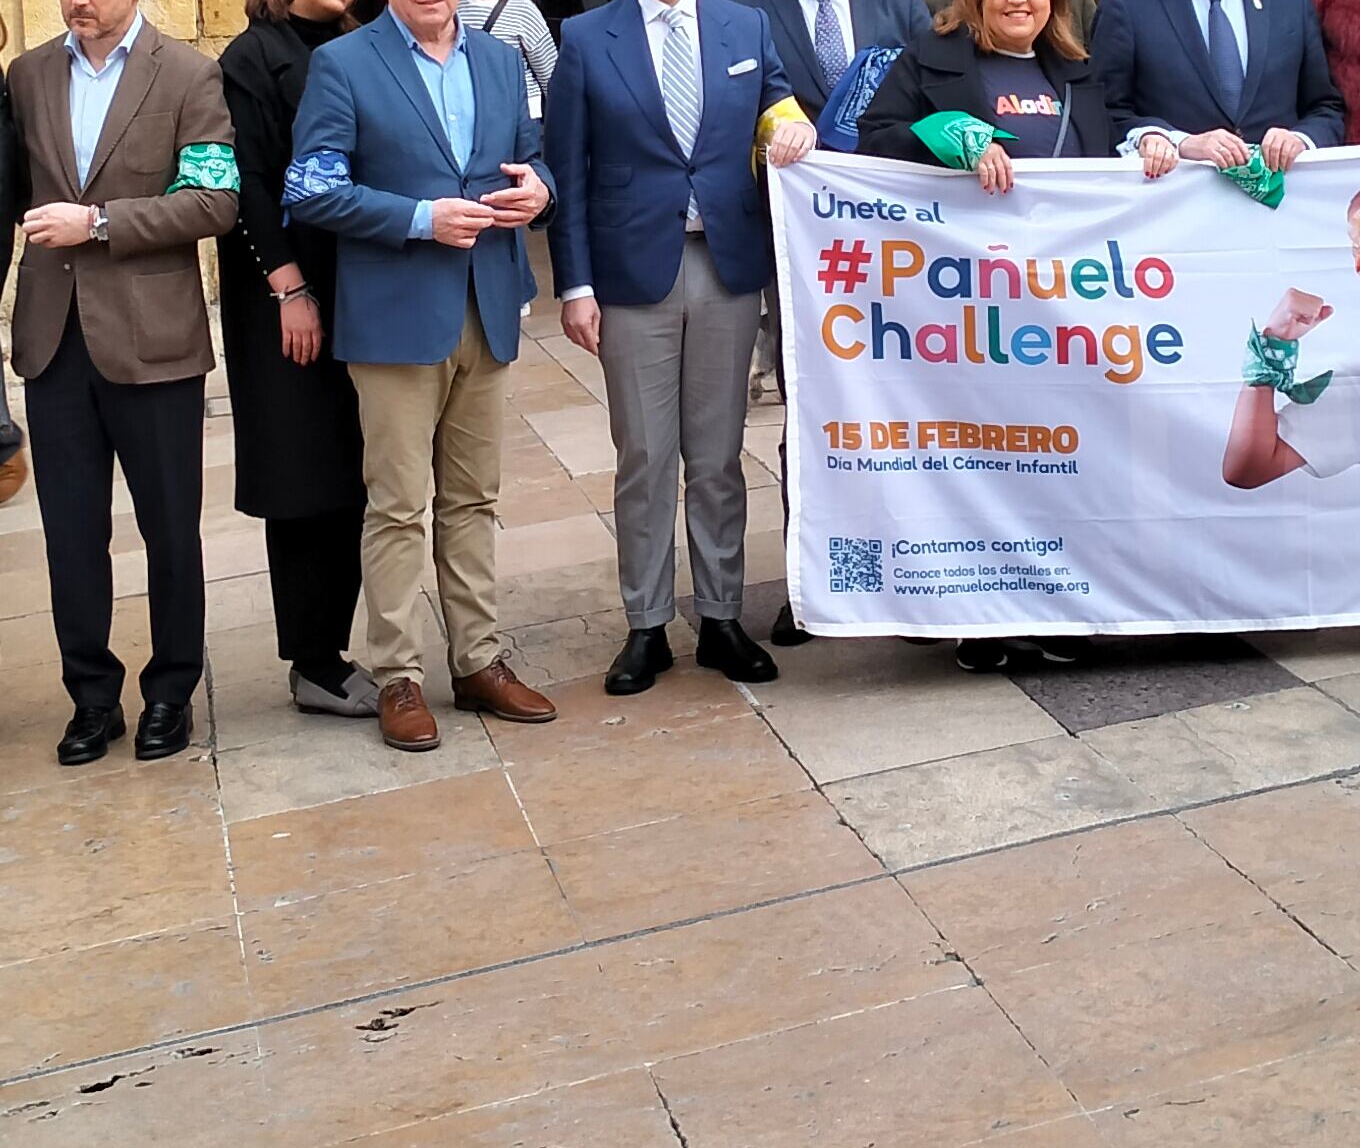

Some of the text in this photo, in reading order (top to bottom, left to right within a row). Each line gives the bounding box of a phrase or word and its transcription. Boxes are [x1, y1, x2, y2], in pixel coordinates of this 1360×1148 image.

[812, 185, 945, 224] Únete al
[817, 239, 1175, 300] #Pañuelo
[821, 301, 1184, 385] Challenge
[822, 420, 1079, 455] 15 DE FEBRERO
[827, 455, 1079, 474] Día Mundial del Cáncer Infantil
[892, 537, 1063, 558] ¡Contamos contigo!
[893, 567, 941, 579] Conoce
[943, 565, 976, 578] todos
[978, 563, 997, 576] los
[1000, 563, 1052, 577] detalles
[893, 577, 1090, 598] www.panuelochallenge.org
